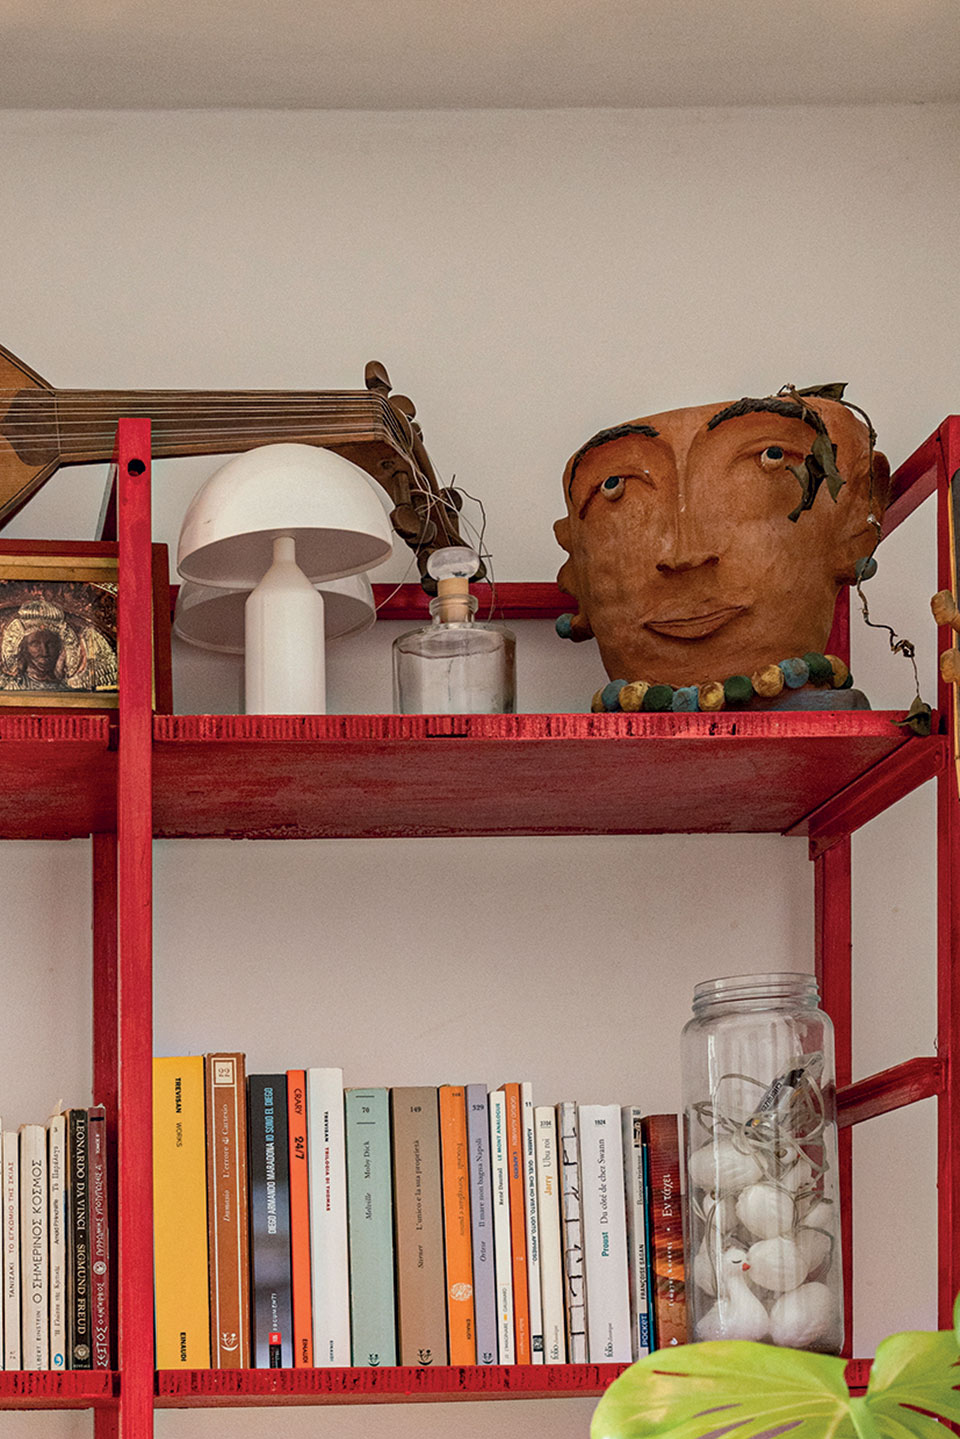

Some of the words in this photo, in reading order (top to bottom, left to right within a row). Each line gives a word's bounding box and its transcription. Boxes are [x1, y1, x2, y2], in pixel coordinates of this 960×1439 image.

[264, 1088, 273, 1106] DIEGO
[294, 1088, 303, 1115] CRARY
[264, 1107, 273, 1115] EL
[265, 1115, 274, 1133] SONO
[175, 1122, 183, 1147] WORKS
[265, 1134, 274, 1142] IO
[75, 1119, 86, 1179] LEONARDO
[295, 1136, 305, 1159] 24/7
[363, 1141, 371, 1157] Dick
[542, 1139, 551, 1153] roi
[596, 1139, 606, 1164] Swann
[265, 1143, 275, 1180] MARADONA
[496, 1154, 503, 1162] LE
[542, 1155, 551, 1167] Ubu
[363, 1159, 372, 1179] Moby
[597, 1166, 606, 1183] chez
[32, 1159, 42, 1214] ΚΟΣΜΟΣ
[76, 1183, 86, 1198] DA
[543, 1176, 553, 1197] Jarry
[597, 1184, 606, 1192] de
[266, 1182, 276, 1214] ARMANDO
[364, 1192, 373, 1221] Melville
[598, 1194, 607, 1212] côté
[76, 1199, 86, 1230] VINCI
[267, 1215, 276, 1234] DIEGO
[599, 1214, 607, 1224] Du
[32, 1218, 42, 1289] ΣΗΜΕΡΙΝΟΣ
[600, 1232, 609, 1257] Proust
[76, 1243, 86, 1295] SIGMUND
[32, 1293, 42, 1304] Ο
[76, 1298, 87, 1335] FREUD
